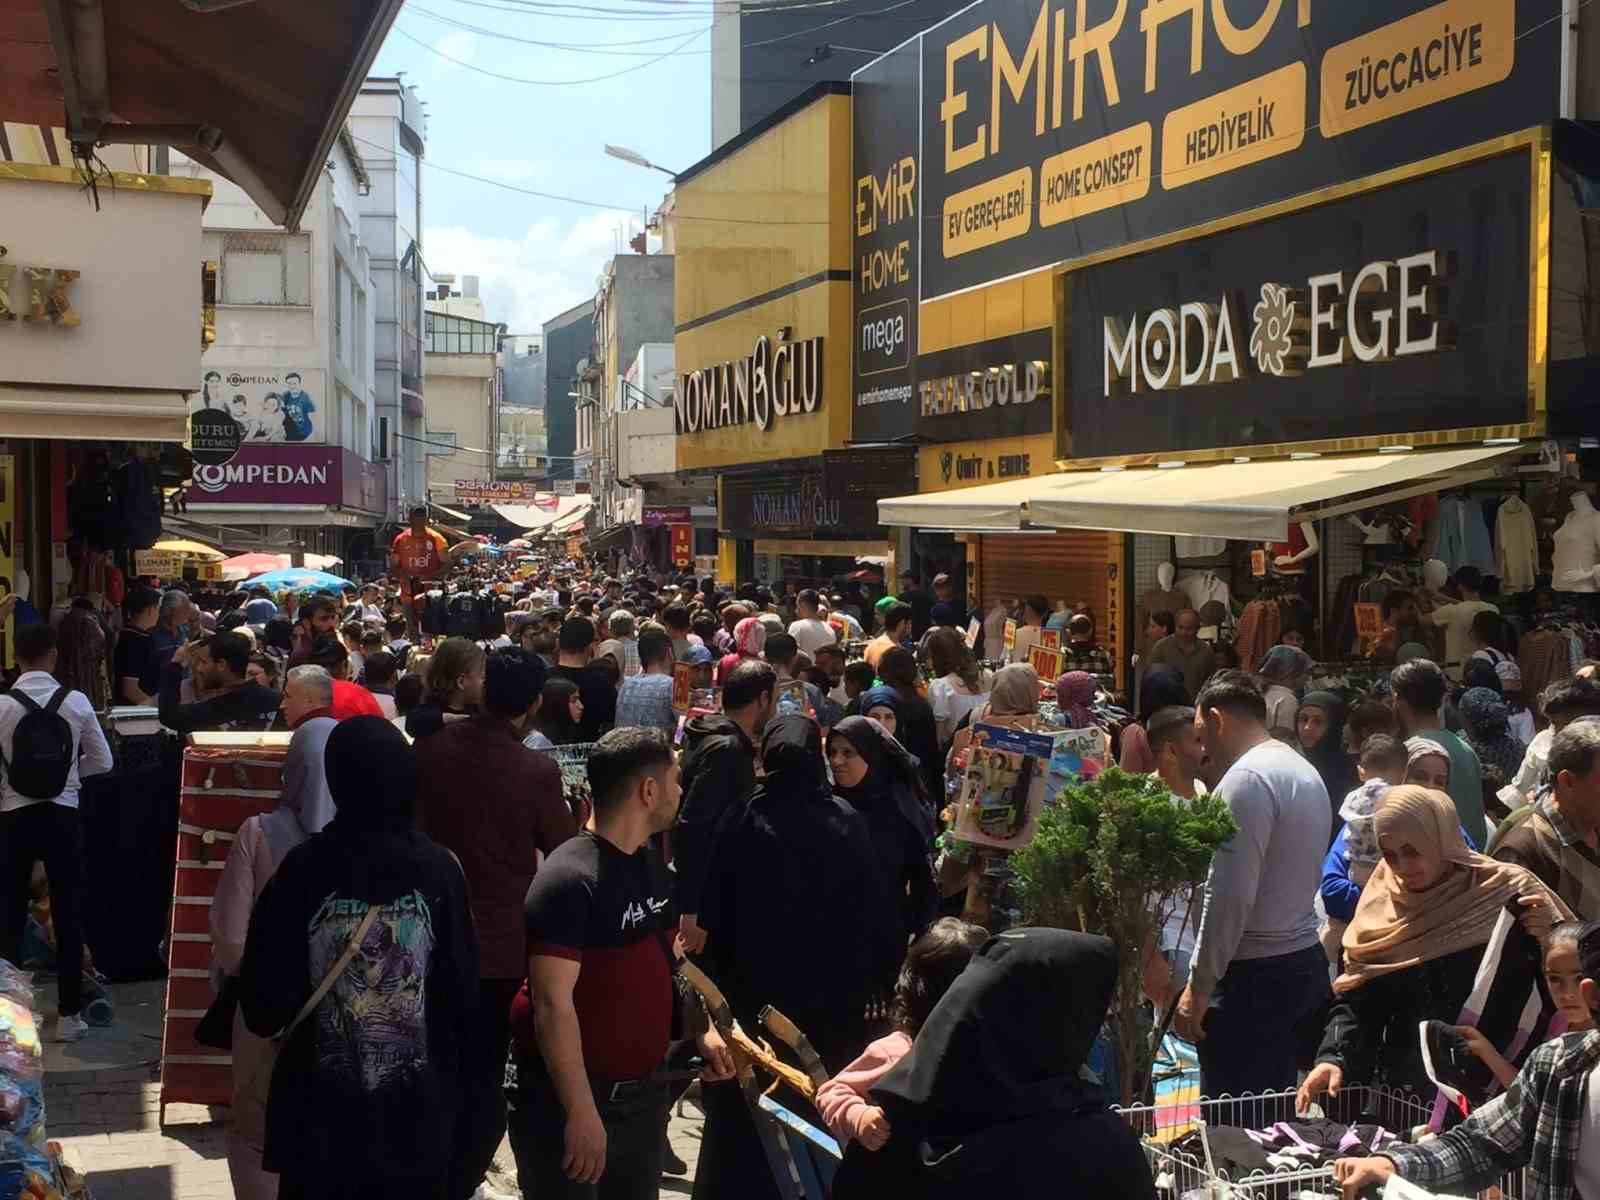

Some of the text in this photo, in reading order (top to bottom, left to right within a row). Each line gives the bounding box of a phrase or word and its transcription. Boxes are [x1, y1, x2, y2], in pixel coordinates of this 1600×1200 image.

[1345, 22, 1482, 110] ZÜCCACİYE
[1186, 97, 1276, 165] HEDİYELİK
[856, 156, 915, 237] EMİR
[1047, 146, 1142, 206] HOME CONSEPT
[949, 181, 1025, 240] EV GEREÇLERİ
[861, 240, 909, 295] HOME
[863, 315, 904, 356] mega
[1104, 250, 1439, 397] MODA EGE
[226, 373, 279, 387] KOMPEDAN
[673, 327, 823, 434] NOMANOĞLU
[192, 464, 326, 487] KOMPEDAN
